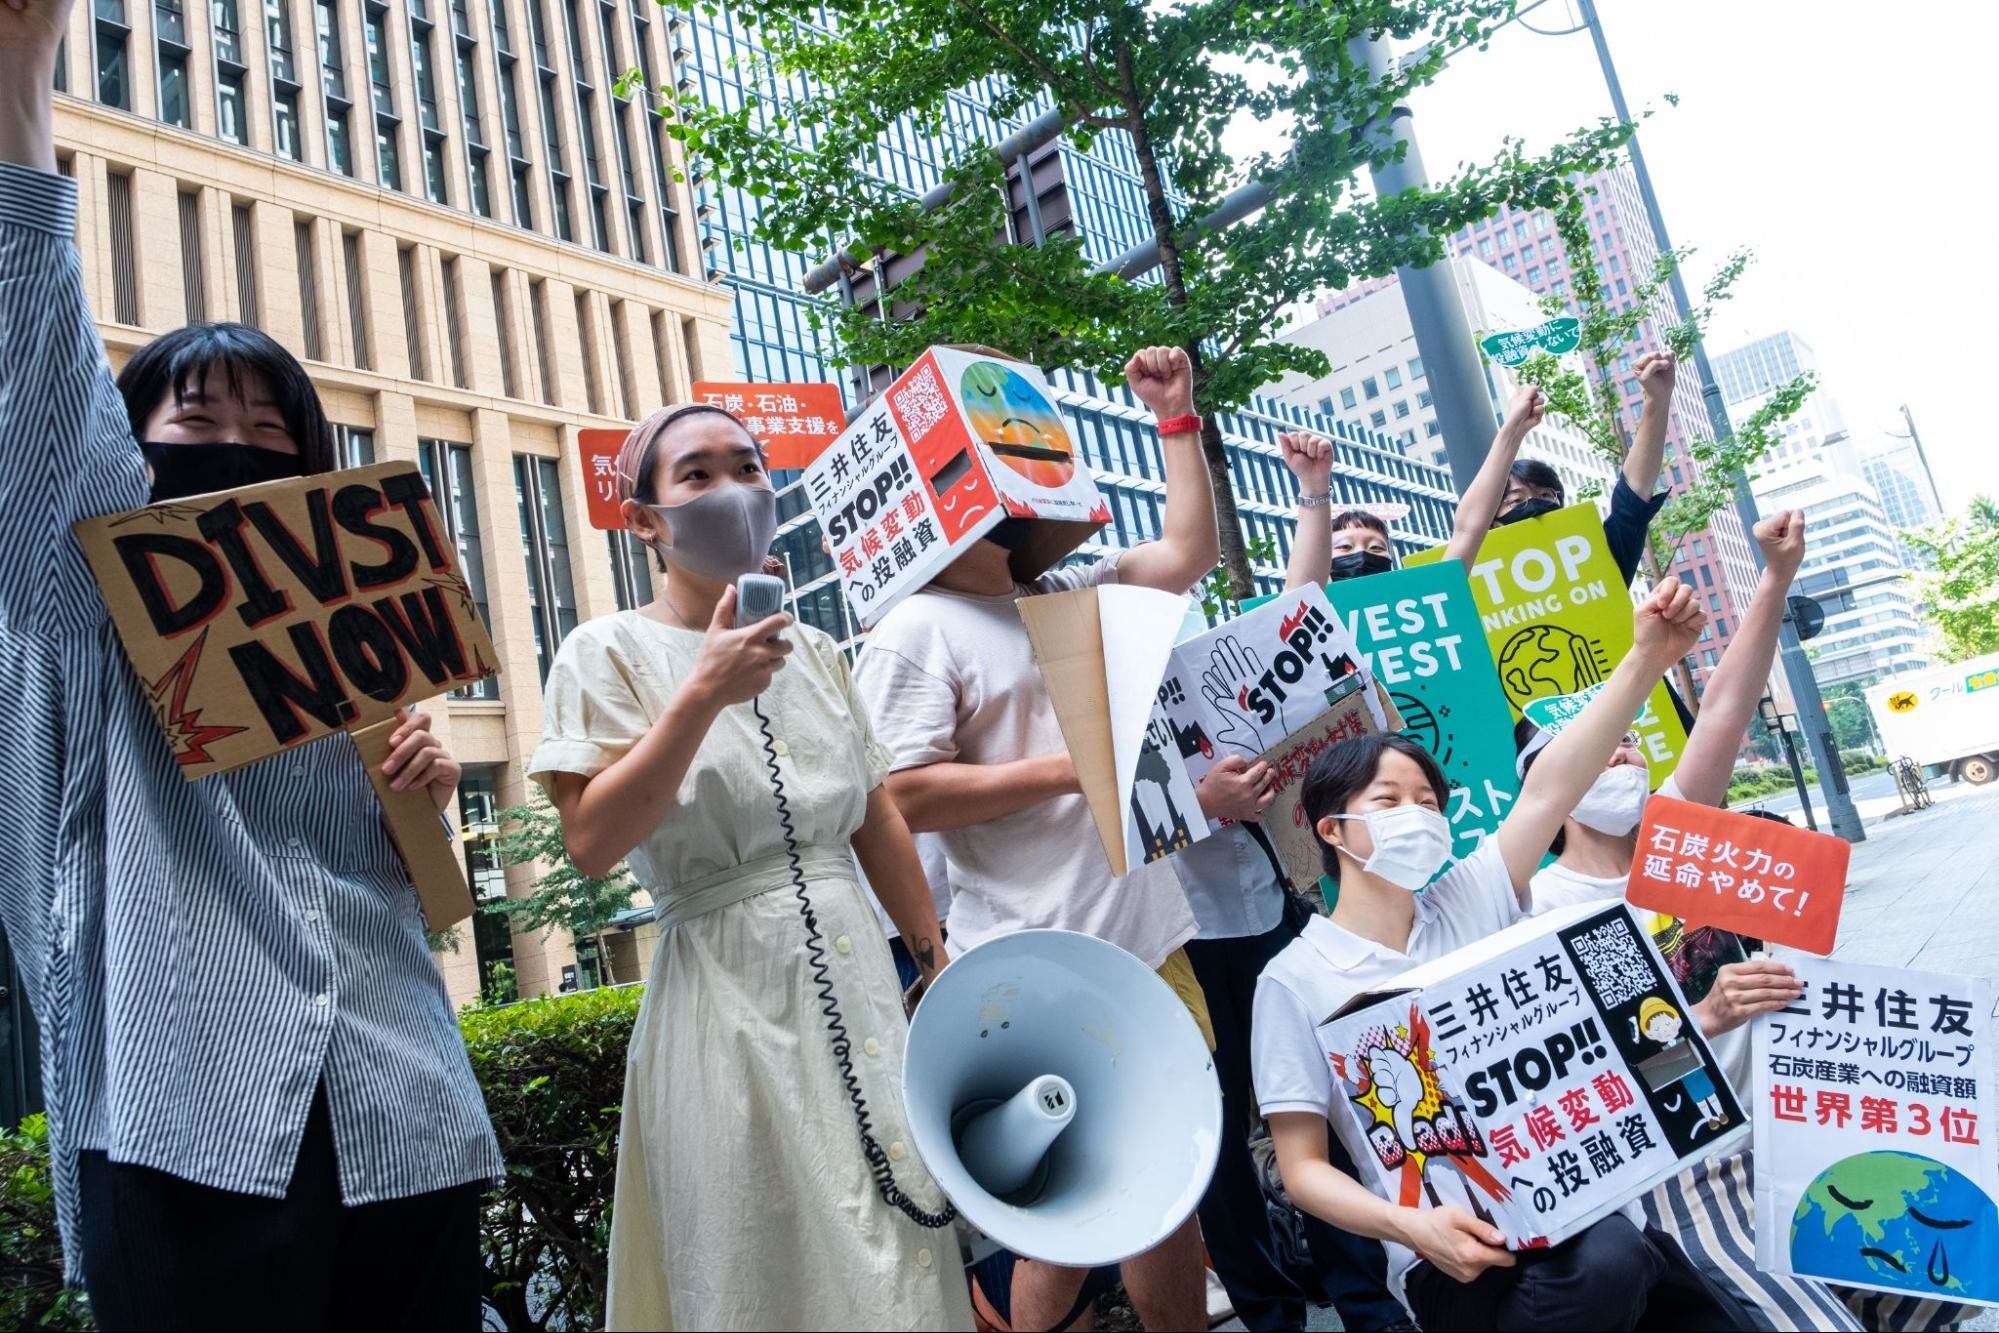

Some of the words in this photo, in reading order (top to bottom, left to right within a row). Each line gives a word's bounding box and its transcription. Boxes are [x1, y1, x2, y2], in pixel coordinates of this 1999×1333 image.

[744, 416, 838, 435] 事業支援を
[810, 412, 893, 502] 三井住友
[591, 454, 619, 476] 気
[819, 433, 899, 515] フィナンシャルグループ
[828, 453, 913, 547] STOP!!
[113, 471, 451, 638] DIVST
[838, 490, 926, 577] 気候変動
[848, 517, 938, 602] への投融資
[1470, 535, 1592, 605] TOP
[1346, 592, 1449, 642] VEST
[1482, 593, 1563, 633] NKING
[1569, 580, 1608, 605] ON
[228, 586, 471, 746] NOW
[1154, 676, 1186, 710] P!!
[1247, 605, 1334, 725] STOP!!
[1930, 681, 1963, 700] クール
[1450, 779, 1512, 824] スト
[1643, 853, 1811, 917] 延命やめて!
[1650, 824, 1795, 880] 石炭火力の
[1428, 953, 1572, 1040] 三井住友
[1446, 986, 1581, 1064] フィナンシャルグループ
[1465, 1016, 1607, 1118] STOP!!
[1769, 1023, 1975, 1067] フィナンシャルグループ
[1769, 1053, 1978, 1100] 石炭産業への融資額
[1489, 1069, 1635, 1169] 気候変動
[1769, 1084, 1980, 1145] 世界第3位
[1510, 1112, 1656, 1213] への投融資
